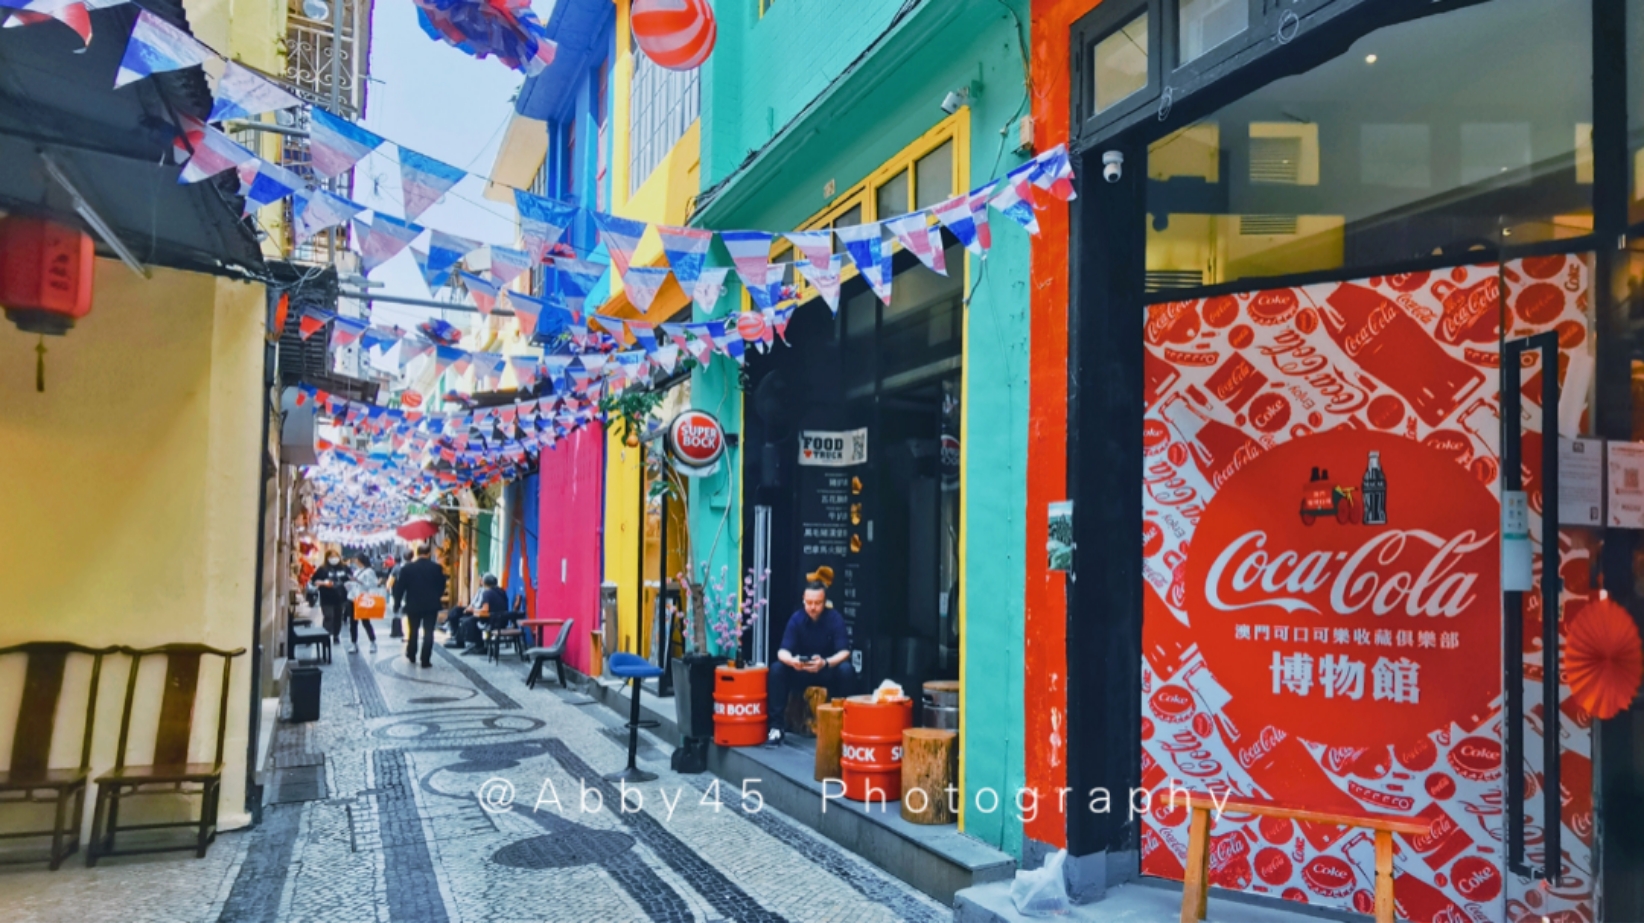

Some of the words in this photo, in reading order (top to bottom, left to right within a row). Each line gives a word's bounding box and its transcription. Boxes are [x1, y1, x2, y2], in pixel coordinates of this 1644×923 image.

[1257, 294, 1291, 306] Coke
[1255, 399, 1285, 428] Coke
[681, 425, 717, 439] SUPER
[1143, 428, 1164, 437] oke
[683, 437, 716, 449] BOCK
[803, 437, 843, 451] FOOD
[813, 451, 843, 459] TRUCK
[1235, 624, 1460, 649] 澳門可口可樂收藏俱樂部
[1269, 650, 1421, 704] 博物館
[1158, 692, 1189, 705] Coke
[727, 703, 761, 716] BOCK
[1460, 745, 1501, 760] Coke
[1313, 862, 1348, 879] Coke
[1457, 866, 1494, 894] Coke
